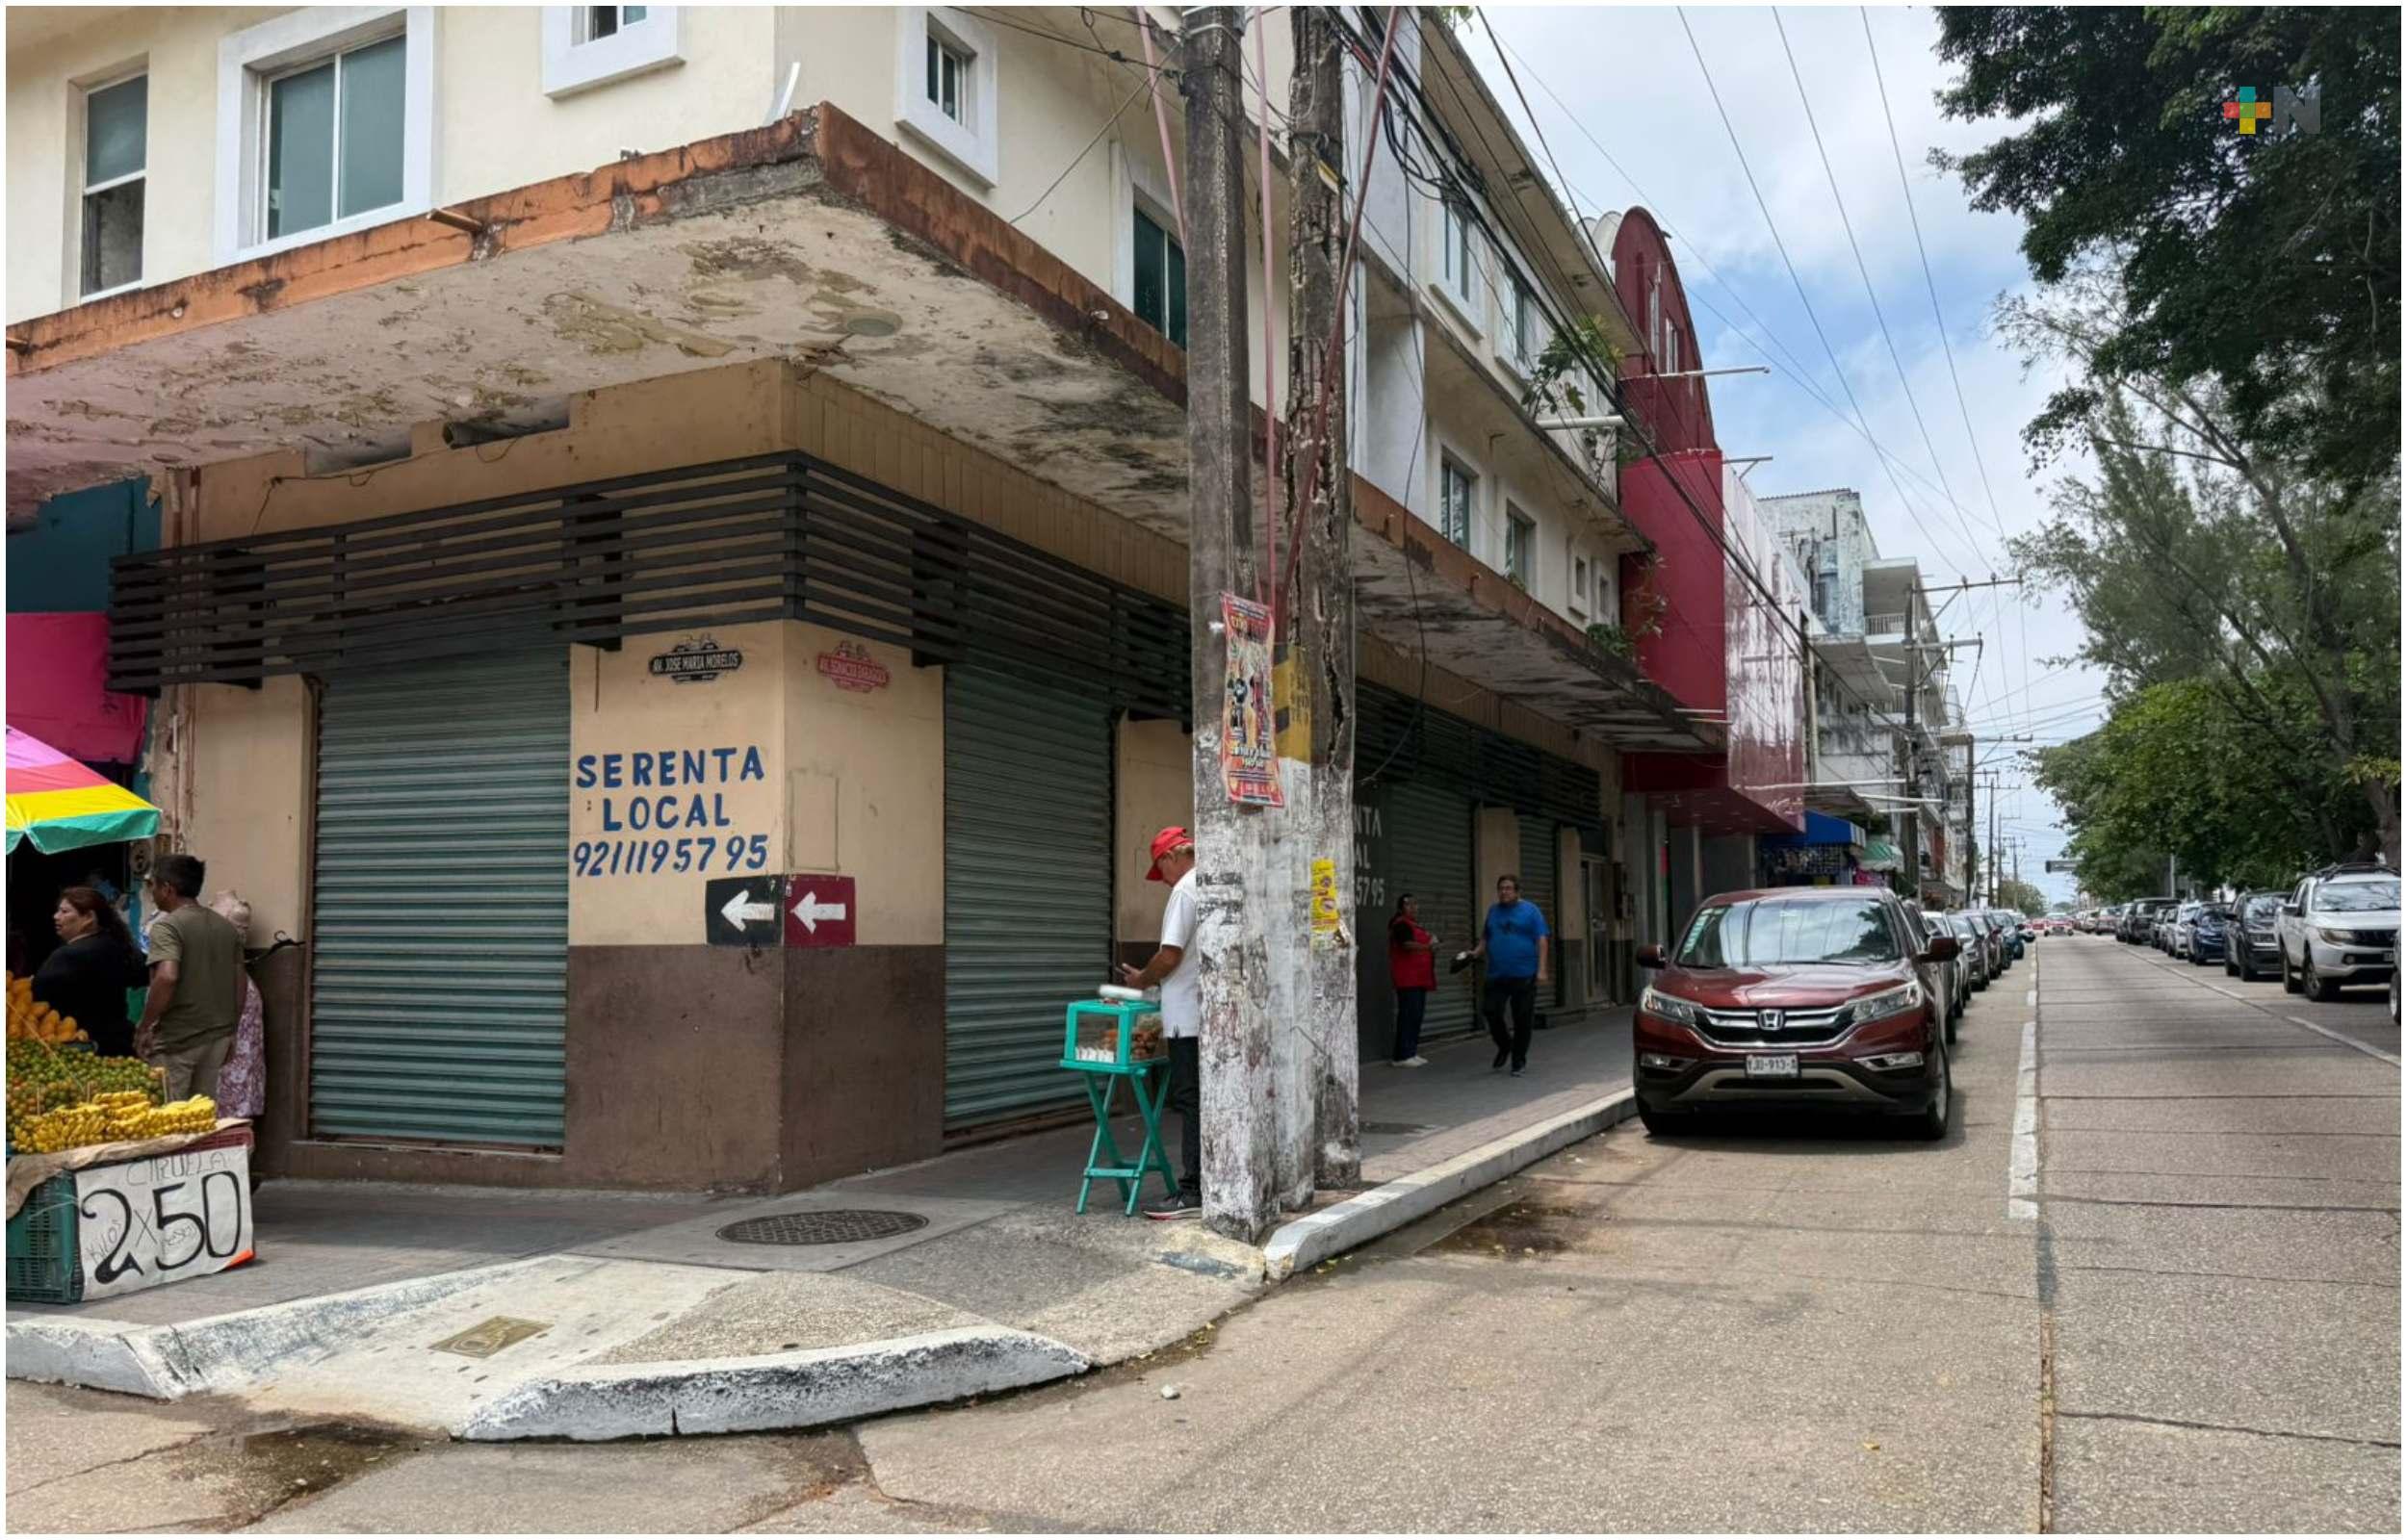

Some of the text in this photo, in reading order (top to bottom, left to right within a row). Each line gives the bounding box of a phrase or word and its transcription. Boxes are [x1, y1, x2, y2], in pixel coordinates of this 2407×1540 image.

[665, 656, 682, 671] JOSE
[683, 654, 705, 670] MARIA
[706, 653, 738, 668] MORELOS
[603, 793, 730, 832] LOCAL
[1354, 805, 1383, 838] NTA
[1355, 842, 1371, 869] AL
[126, 1152, 226, 1186] CIRUELA
[81, 1189, 143, 1284] 2
[152, 1170, 241, 1270] 50
